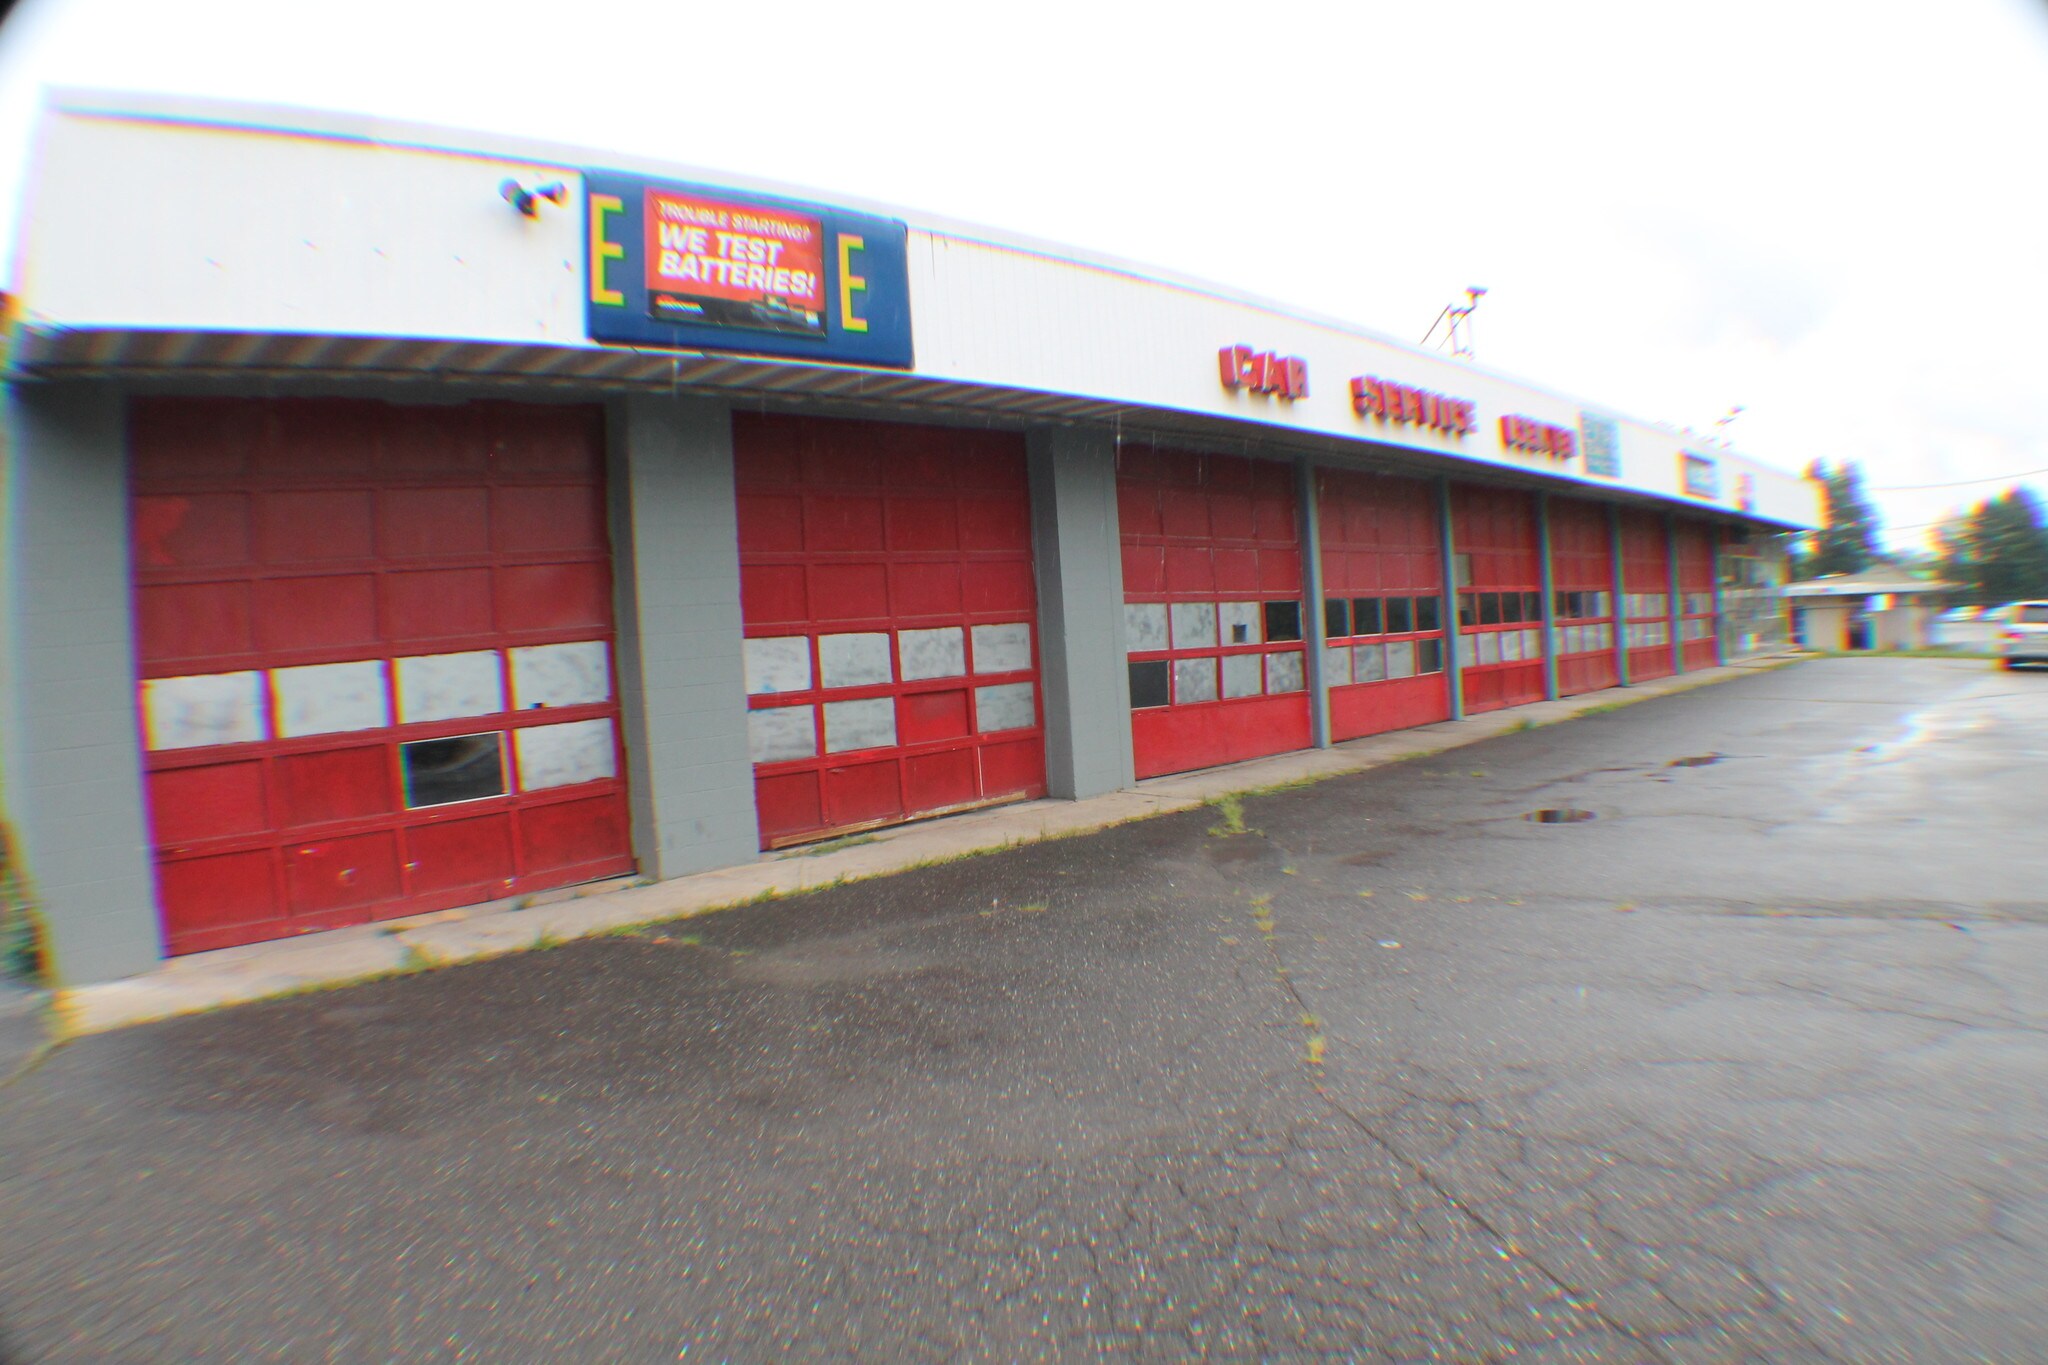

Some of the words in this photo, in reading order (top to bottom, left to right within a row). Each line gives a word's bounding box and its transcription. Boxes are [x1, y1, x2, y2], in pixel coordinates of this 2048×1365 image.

[590, 193, 624, 306] E
[657, 249, 817, 301] BATTERIES!
[658, 221, 709, 254] WE
[715, 231, 784, 267] TEST
[838, 233, 868, 332] E
